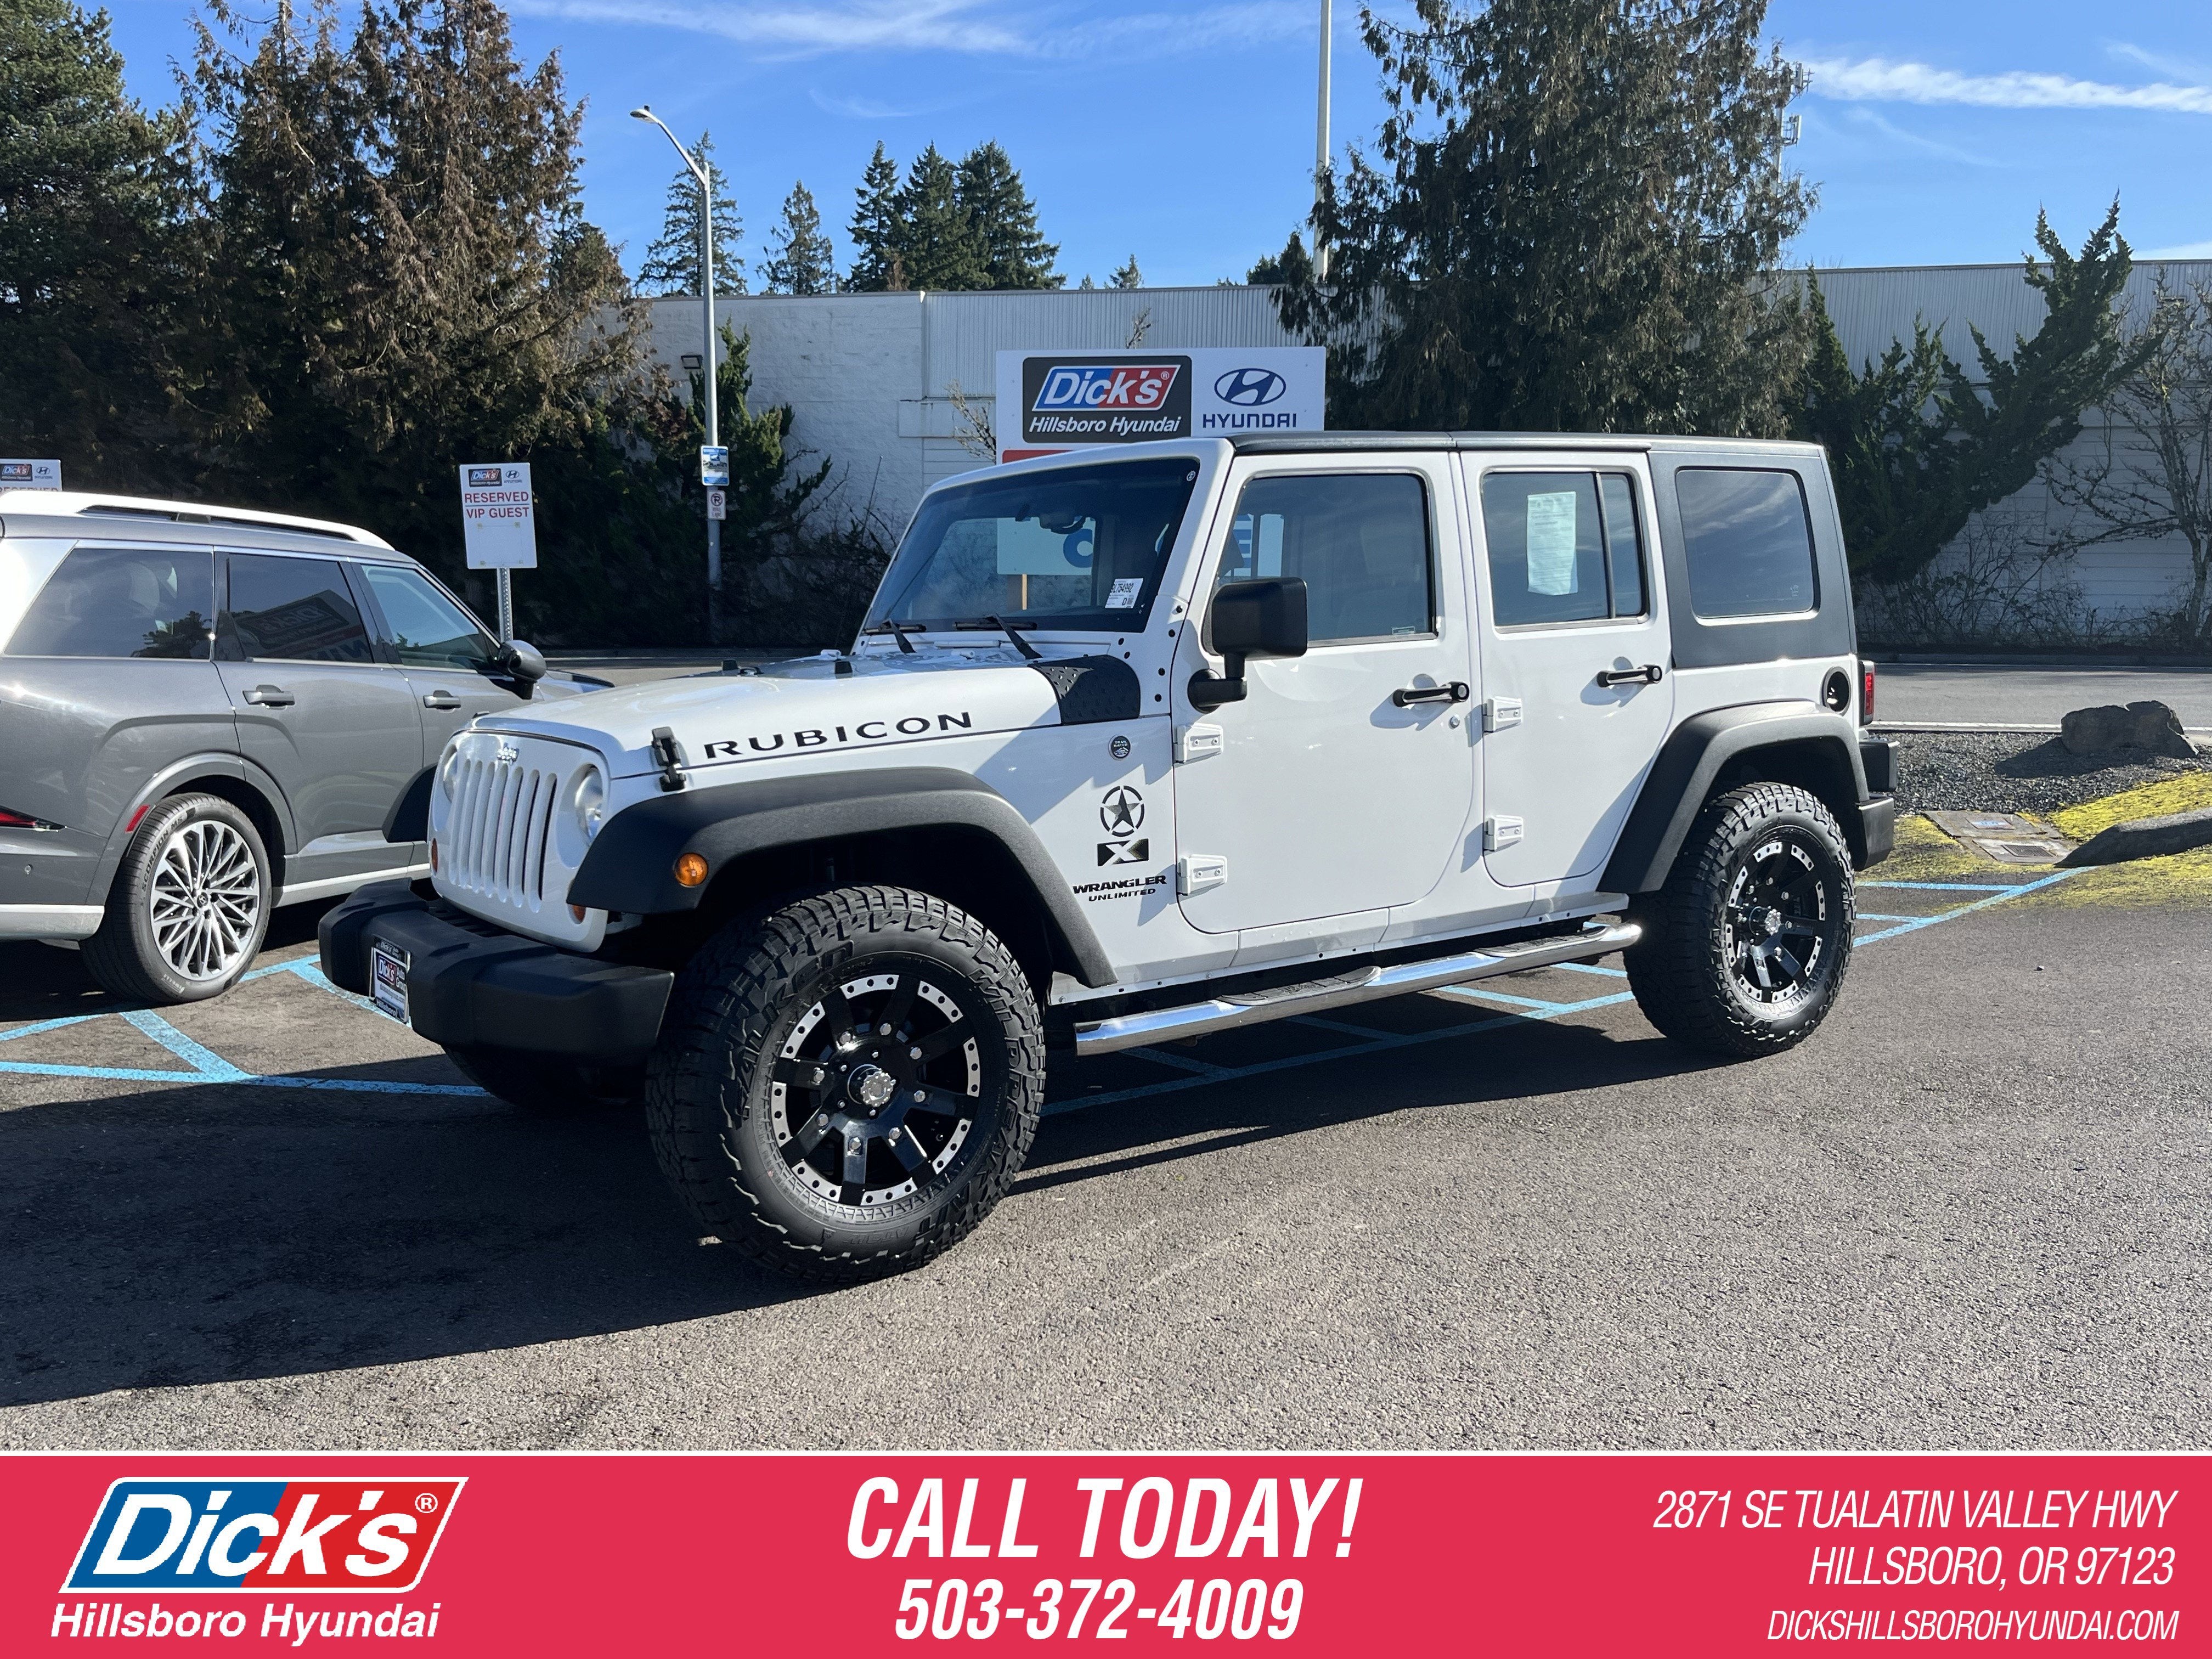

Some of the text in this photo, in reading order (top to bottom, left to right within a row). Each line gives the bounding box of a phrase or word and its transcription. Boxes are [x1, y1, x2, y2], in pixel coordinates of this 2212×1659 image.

[1044, 371, 1162, 404] Dick's
[1029, 416, 1182, 436] Hillsboro Hyundai
[1203, 413, 1296, 428] HYUNDAI
[465, 492, 529, 503] RESERVED
[466, 507, 529, 518] VIP GUEST
[703, 712, 972, 759] RUBICON
[1073, 875, 1167, 894] WRANGLER
[1088, 888, 1156, 902] UNLIMITED
